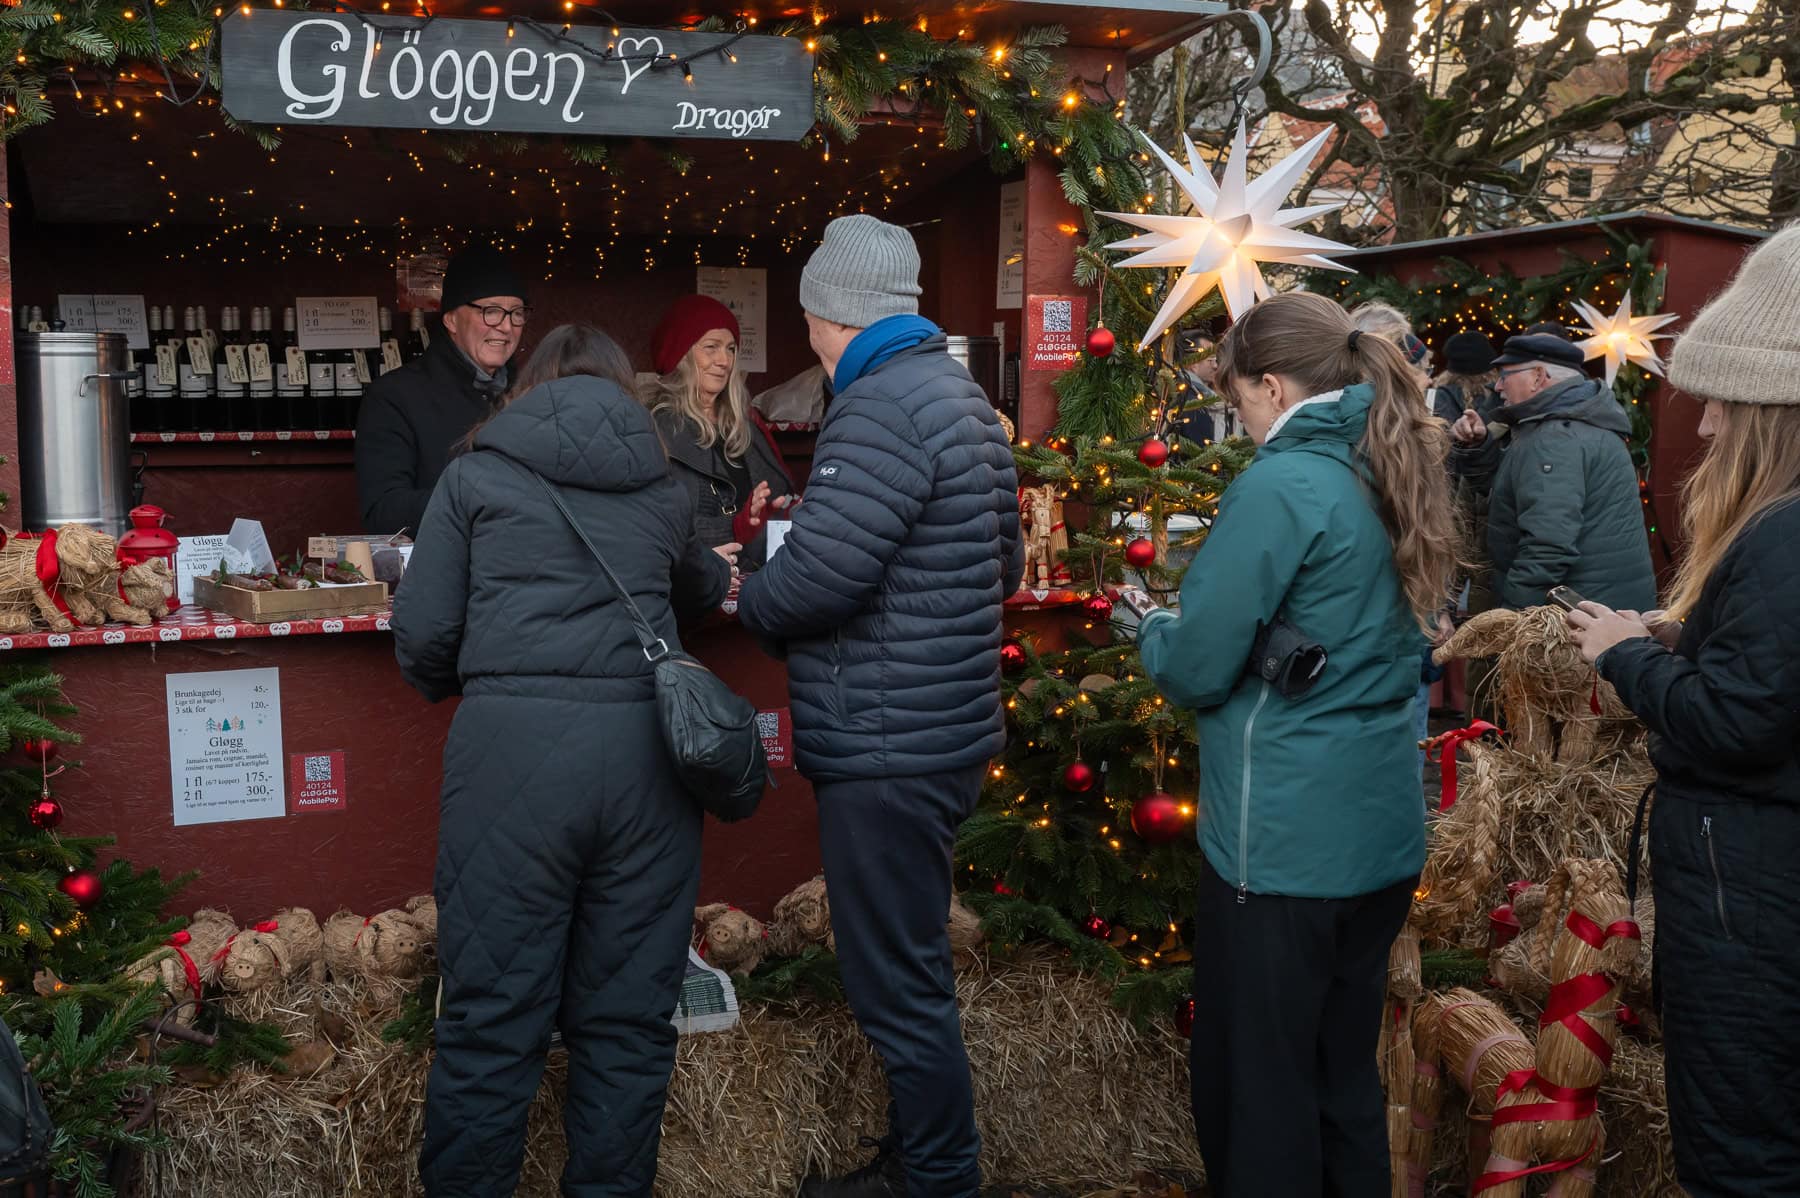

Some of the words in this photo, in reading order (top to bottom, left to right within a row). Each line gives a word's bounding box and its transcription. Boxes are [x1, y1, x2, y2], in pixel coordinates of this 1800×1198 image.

[277, 17, 585, 126] Glöggen
[672, 101, 781, 138] Dragør
[1043, 334, 1071, 342] 40124
[192, 536, 223, 547] Gløgg
[174, 688, 222, 698] Brunkagedej
[210, 736, 244, 748] Gløgg
[186, 778, 189, 788] 1
[306, 782, 331, 790] 40124
[184, 792, 190, 801] 2
[300, 788, 337, 797] GLØGGEN
[299, 796, 339, 805] MobilePay
